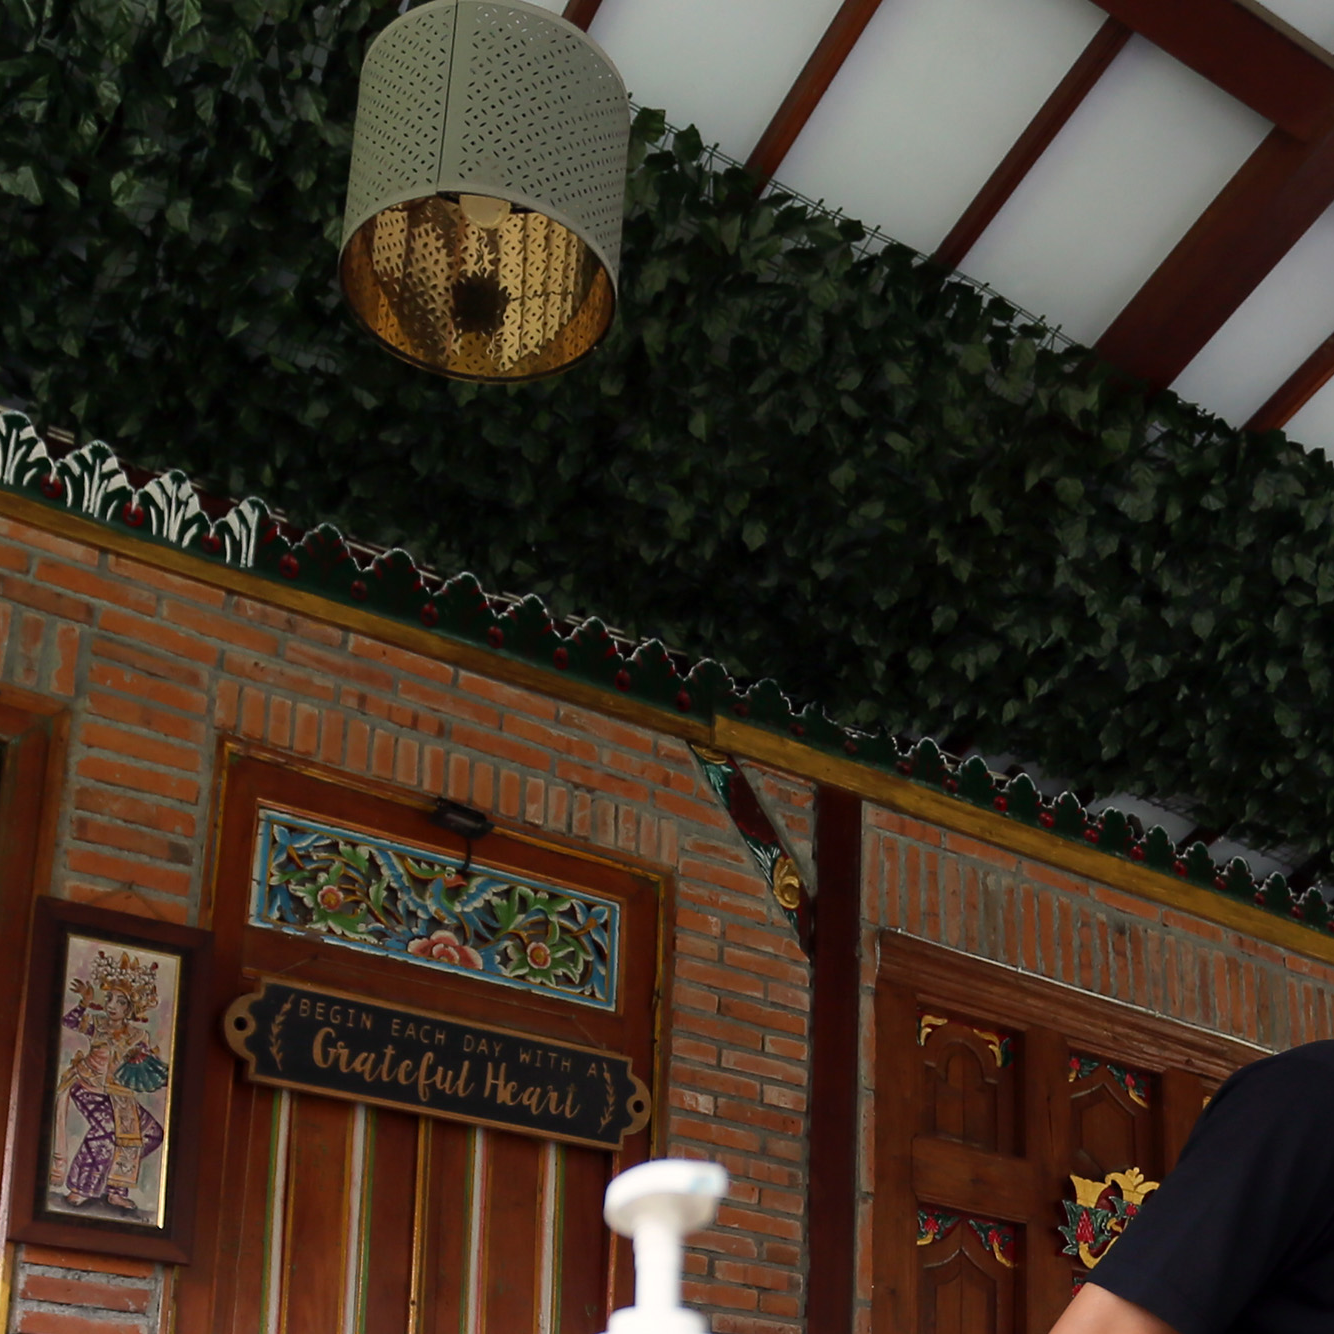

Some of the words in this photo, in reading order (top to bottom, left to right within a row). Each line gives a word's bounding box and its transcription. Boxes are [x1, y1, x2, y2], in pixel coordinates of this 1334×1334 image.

[299, 999, 373, 1031] BEGIN
[390, 1018, 446, 1046] EACH
[463, 1034, 503, 1057] DAY
[519, 1047, 571, 1073] WITH
[586, 1062, 598, 1079] A
[312, 1027, 476, 1102] Grateful
[483, 1061, 581, 1119] Heart
